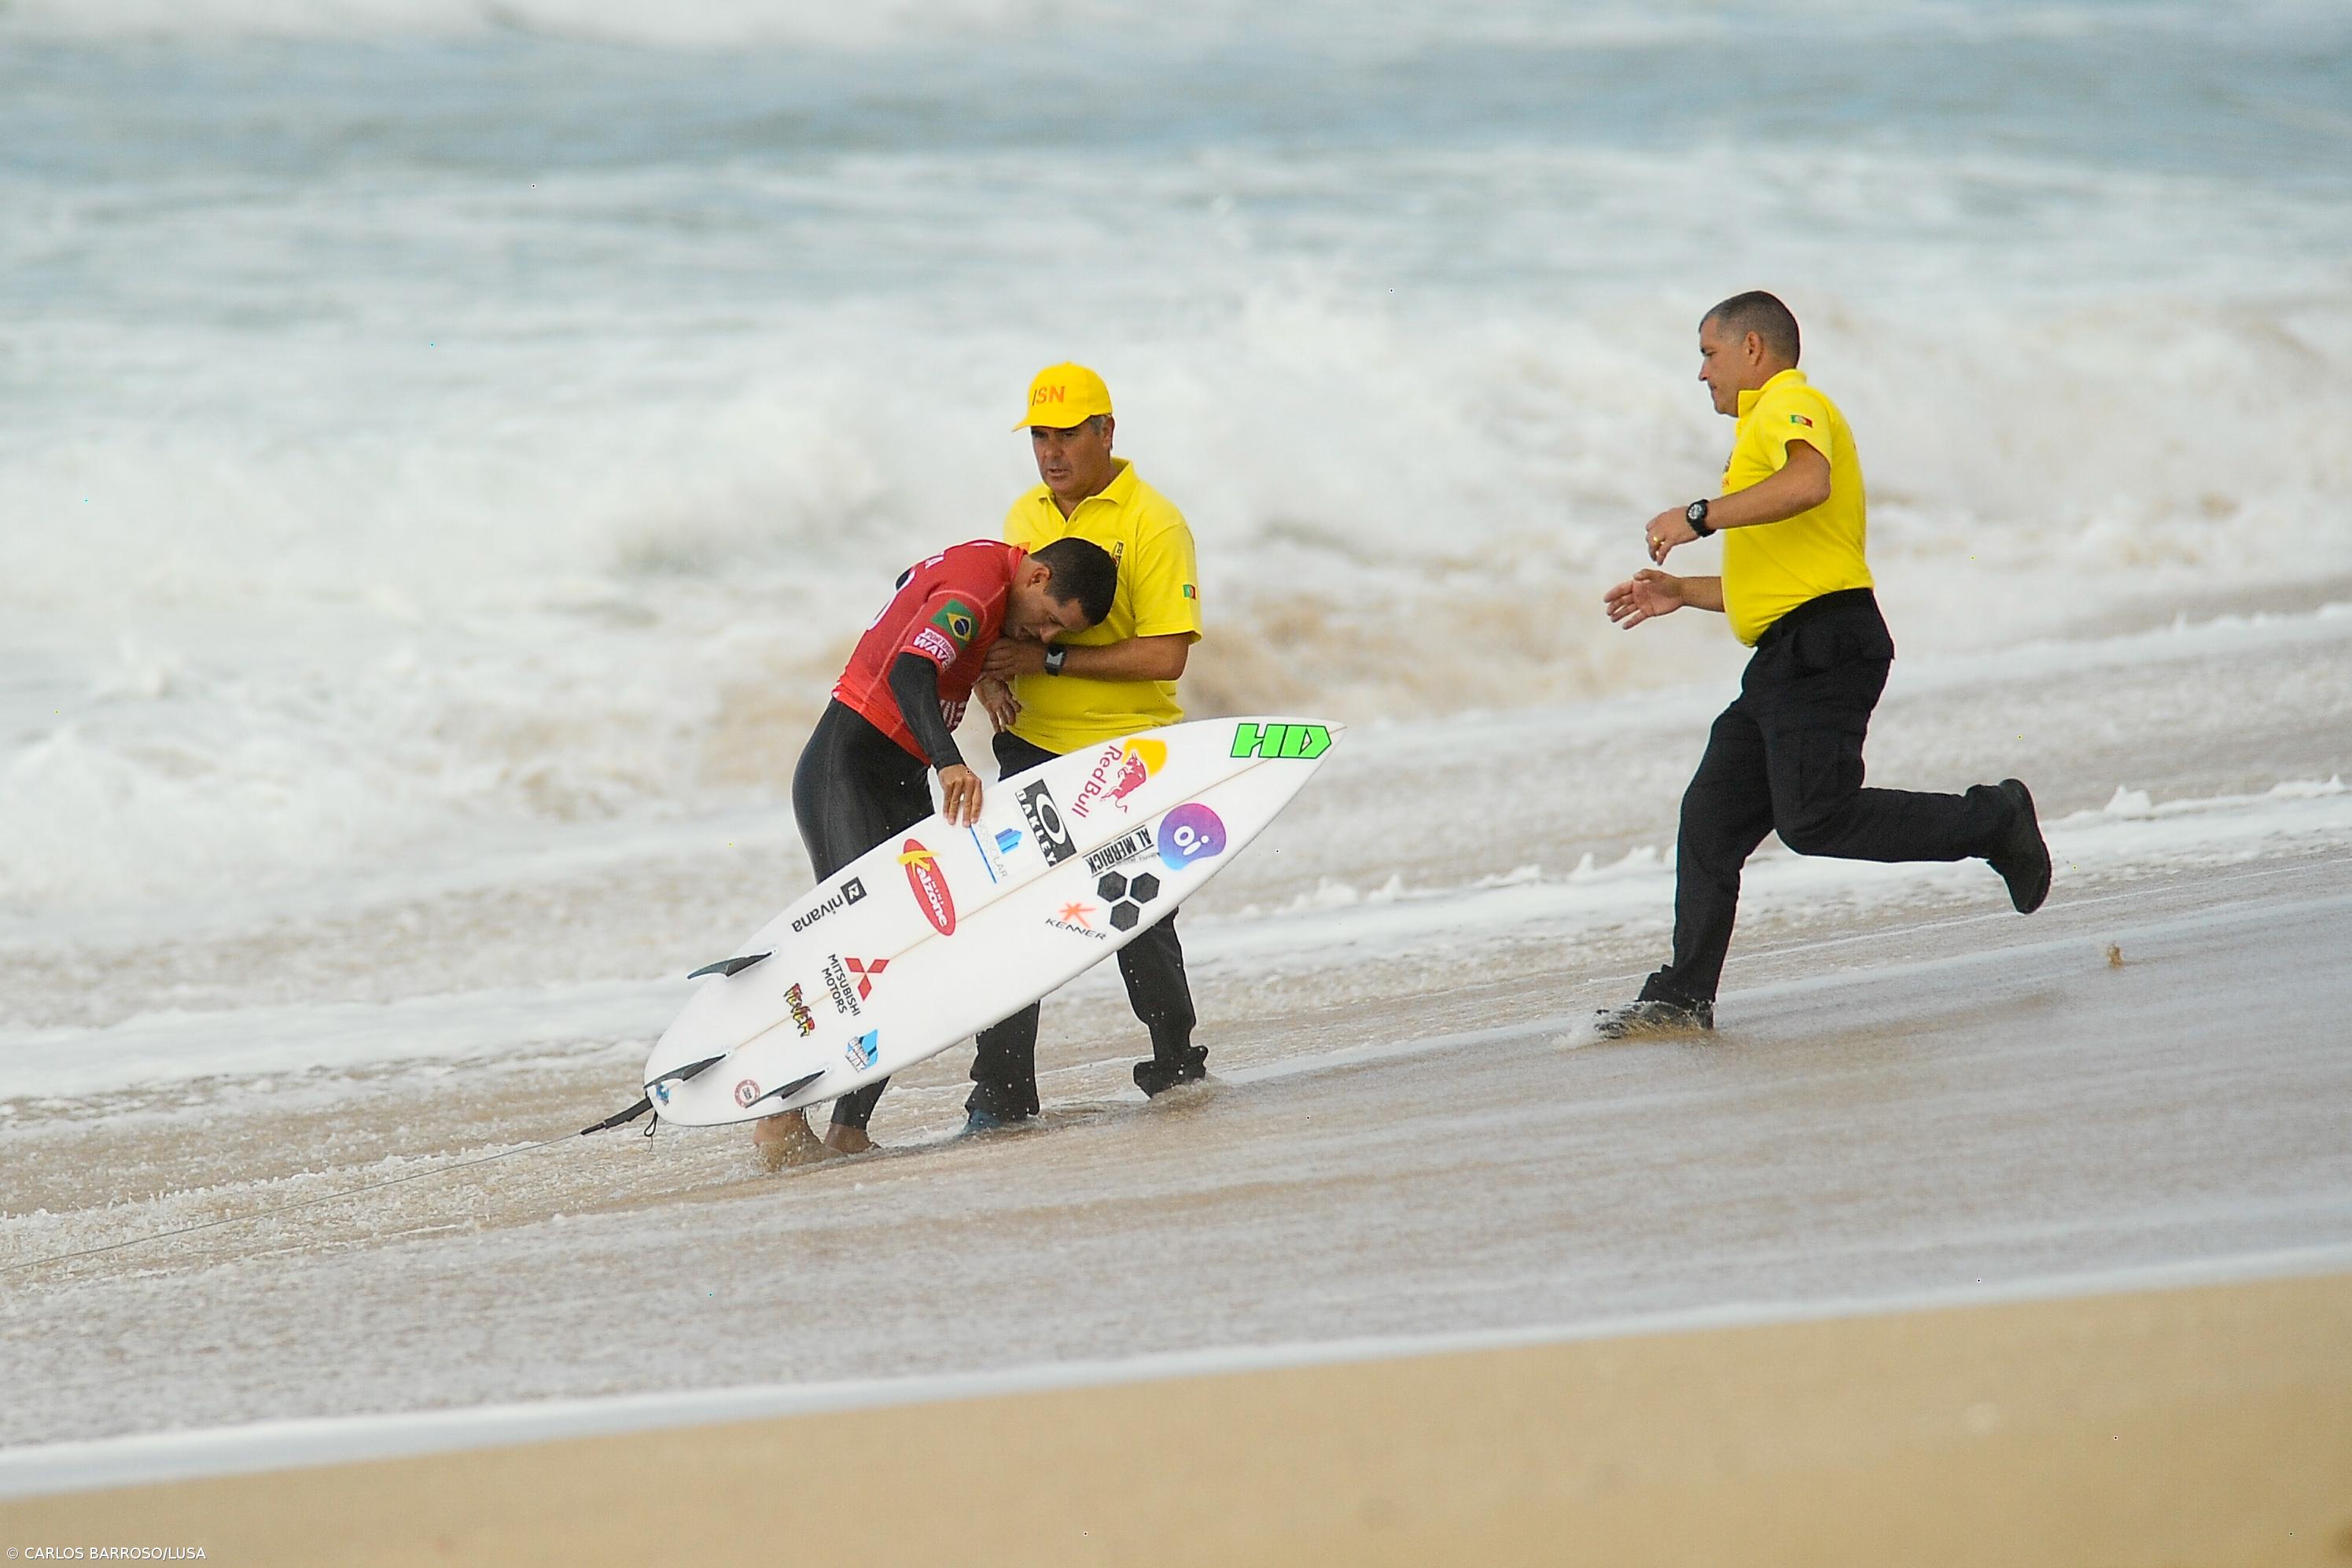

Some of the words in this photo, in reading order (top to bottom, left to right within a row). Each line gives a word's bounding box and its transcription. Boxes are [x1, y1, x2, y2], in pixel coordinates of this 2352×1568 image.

[1032, 385, 1065, 407] ISN
[1230, 723, 1332, 759] HD
[1016, 789, 1058, 864] OAKLEY
[1136, 827, 1152, 848] AL
[1085, 836, 1137, 874] MERRICK
[791, 894, 844, 933] nivana
[1044, 918, 1106, 940] KENNER
[821, 967, 848, 1014] MOTORS
[827, 953, 861, 1016] MITSUBISHI
